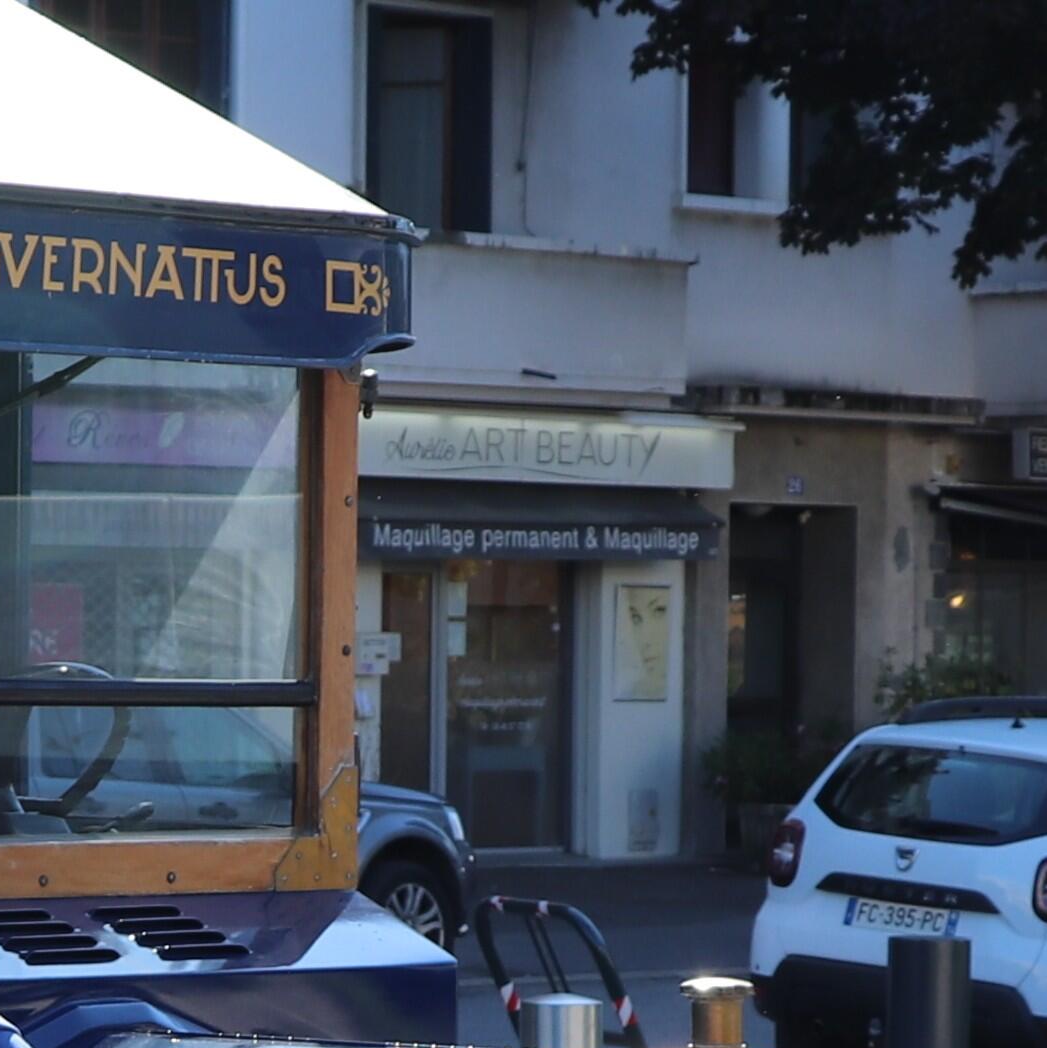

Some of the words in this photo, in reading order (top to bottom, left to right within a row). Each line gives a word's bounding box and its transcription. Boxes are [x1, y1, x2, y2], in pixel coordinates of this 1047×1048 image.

[459, 426, 528, 465] ART
[535, 431, 662, 476] BEAUTY
[373, 522, 475, 552] Maquillage
[481, 525, 580, 553] permanent
[584, 526, 599, 549] &
[603, 525, 700, 555] Maquillage
[856, 901, 945, 933] FC-395-PC
